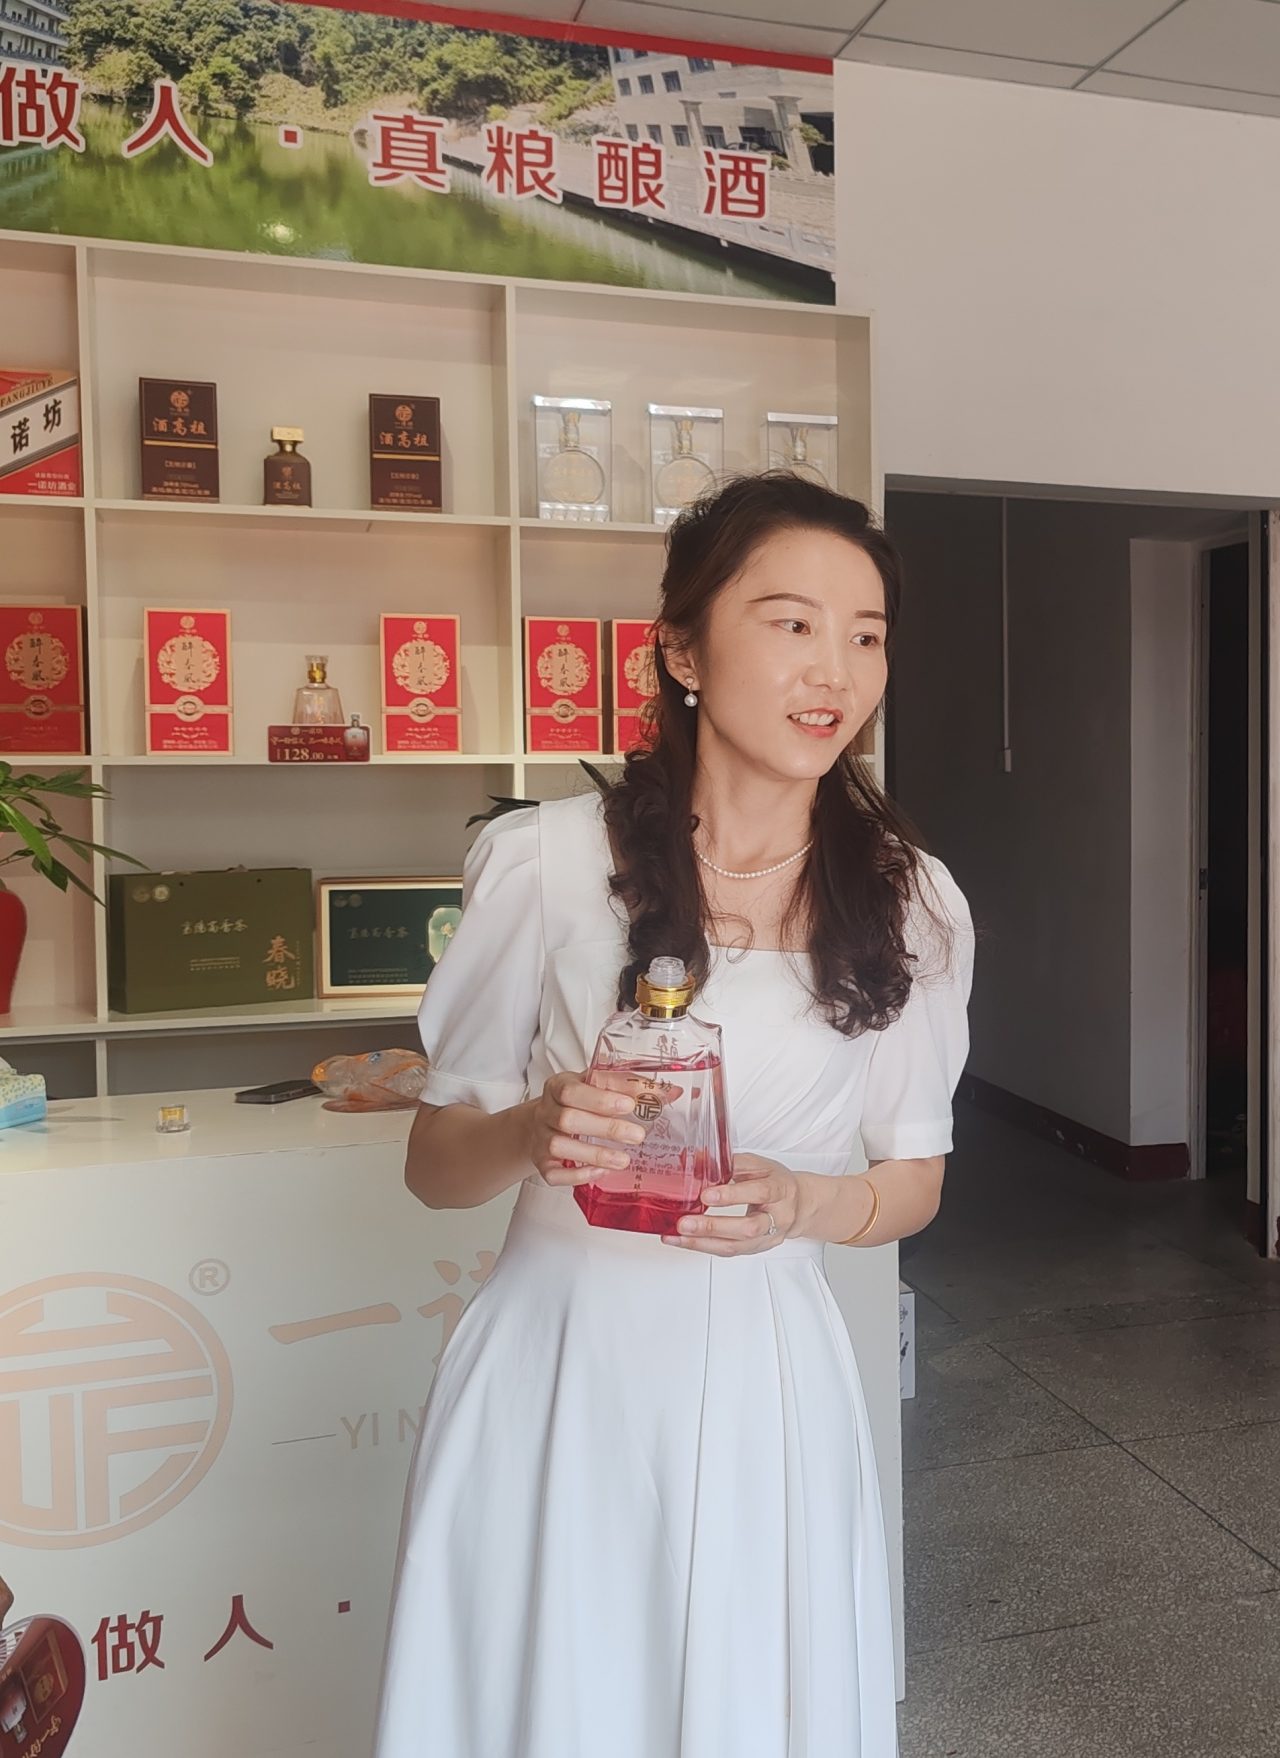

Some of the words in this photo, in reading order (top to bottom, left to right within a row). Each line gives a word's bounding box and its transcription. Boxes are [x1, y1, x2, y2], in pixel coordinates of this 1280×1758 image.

[10, 398, 62, 455] 诺坊
[262, 935, 296, 990] 春晓
[340, 1412, 380, 1450] YI
